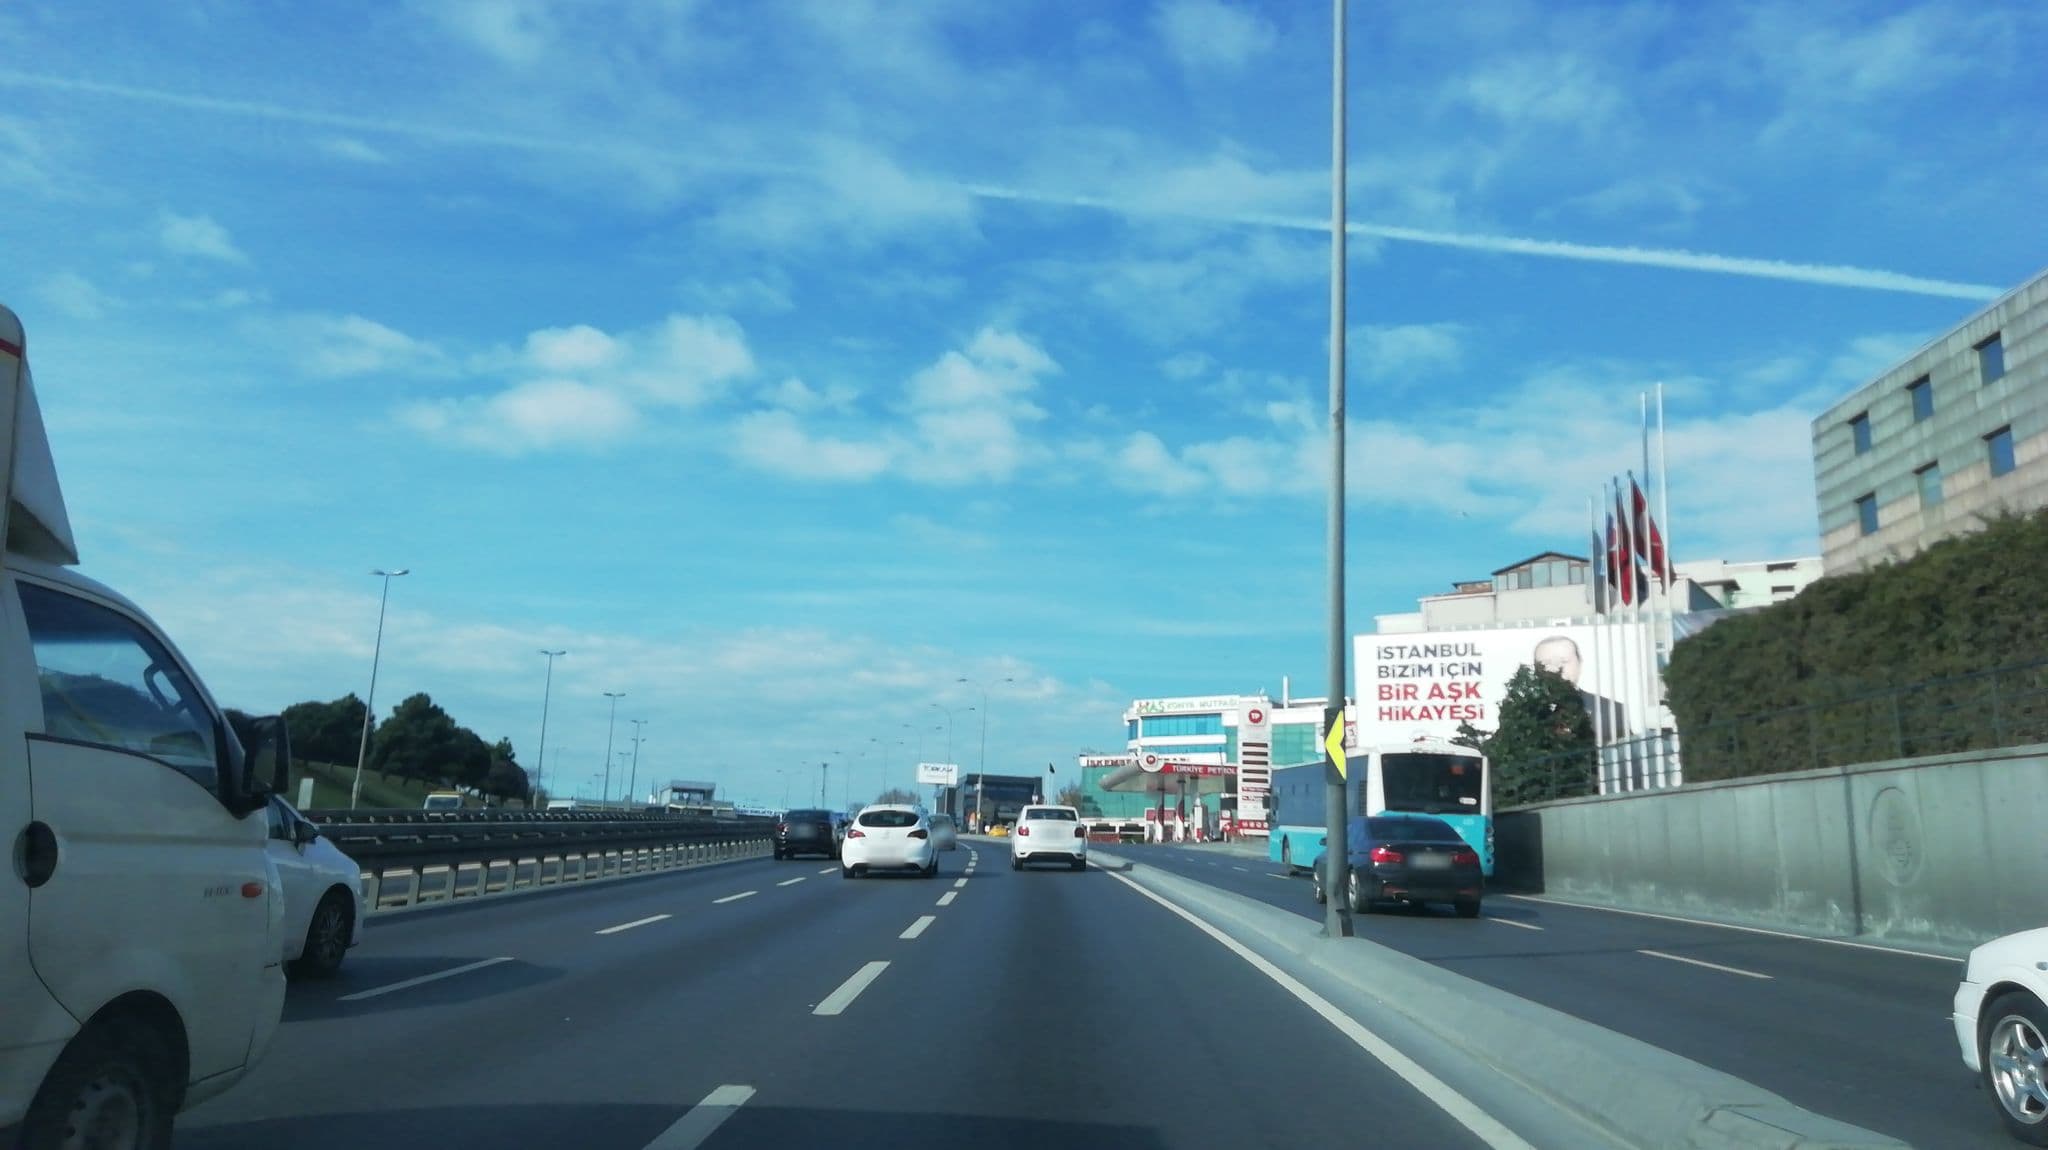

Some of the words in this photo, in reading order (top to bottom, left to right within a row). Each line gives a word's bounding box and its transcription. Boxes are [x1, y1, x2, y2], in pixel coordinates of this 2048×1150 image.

[1377, 643, 1482, 660] İSTANBUL
[1378, 664, 1433, 679] BİZİM
[1440, 662, 1482, 680] İÇİN
[1378, 683, 1418, 701] BİR
[1427, 682, 1482, 703] AŞK
[1379, 704, 1484, 721] HİKAYESİ
